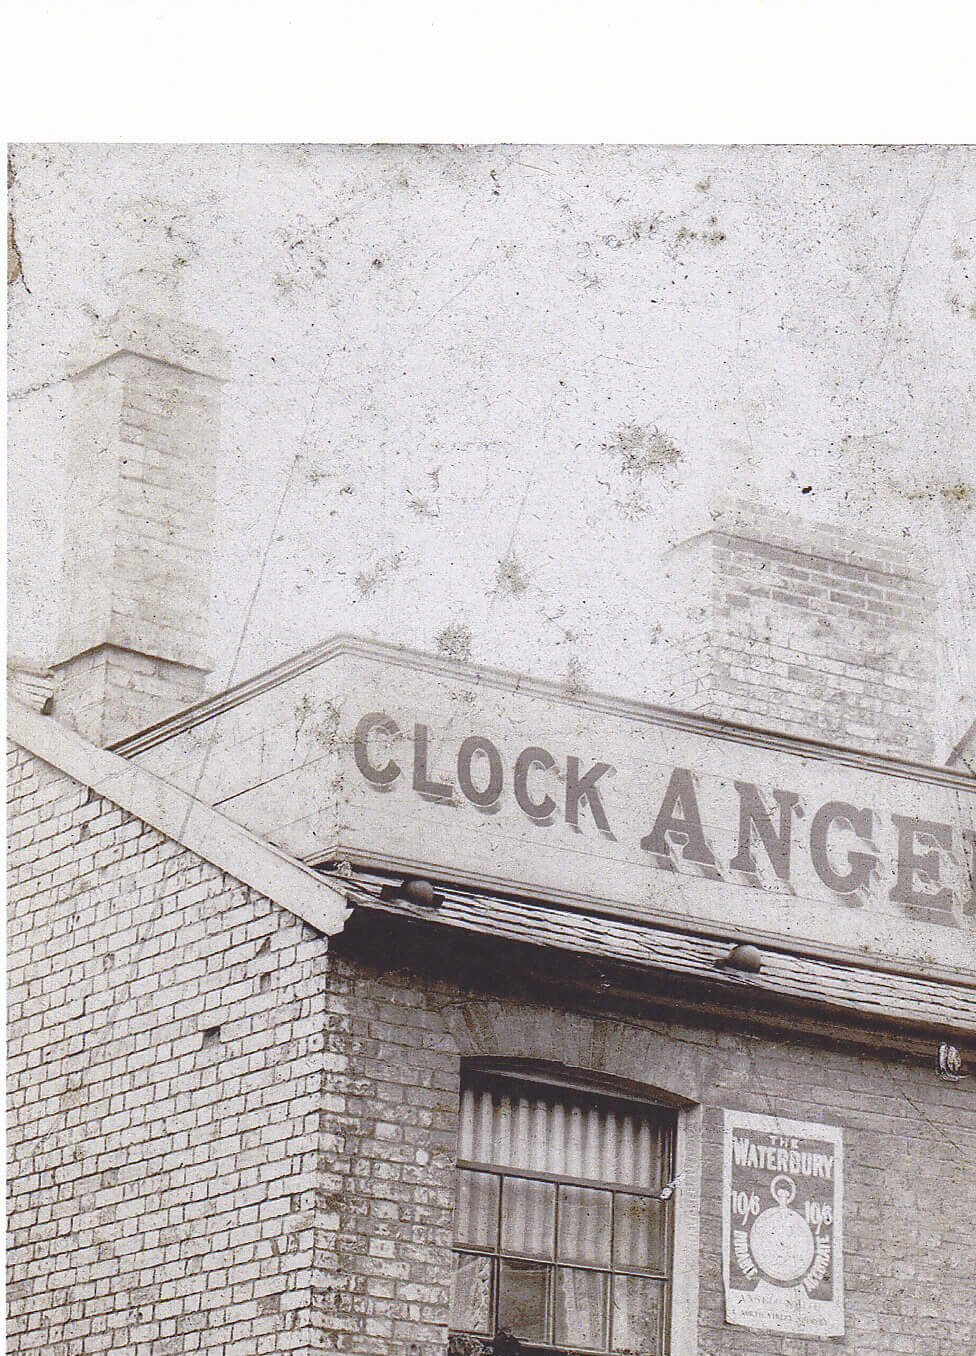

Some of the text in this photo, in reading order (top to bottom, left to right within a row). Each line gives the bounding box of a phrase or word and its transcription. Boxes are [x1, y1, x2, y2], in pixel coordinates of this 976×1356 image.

[353, 710, 618, 842] CLOCK
[732, 1136, 834, 1179] WATERBURY
[768, 1135, 800, 1150] THE
